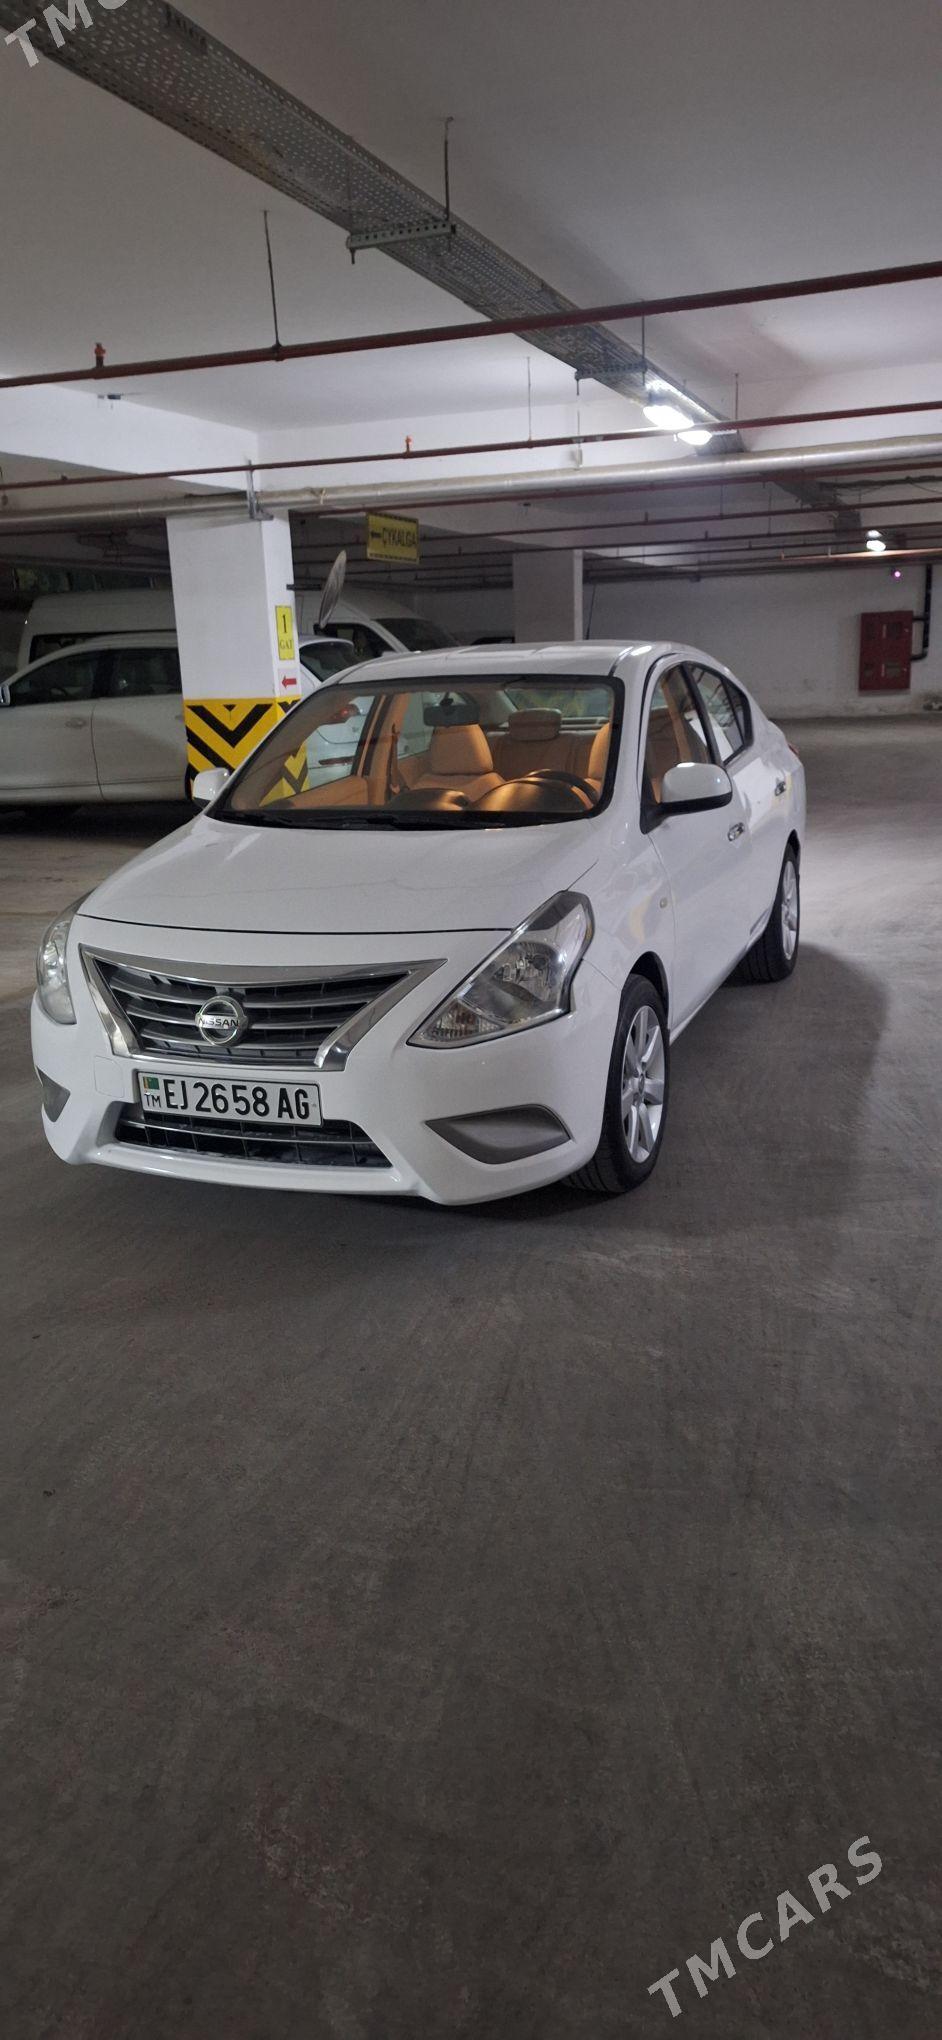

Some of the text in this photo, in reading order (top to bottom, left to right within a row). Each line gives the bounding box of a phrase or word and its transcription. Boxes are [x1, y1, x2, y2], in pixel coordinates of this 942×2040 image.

[282, 614, 288, 634] 1
[199, 1017, 239, 1028] NISSAN
[144, 1092, 162, 1108] TM
[163, 1079, 310, 1120] EJ 2658 AG
